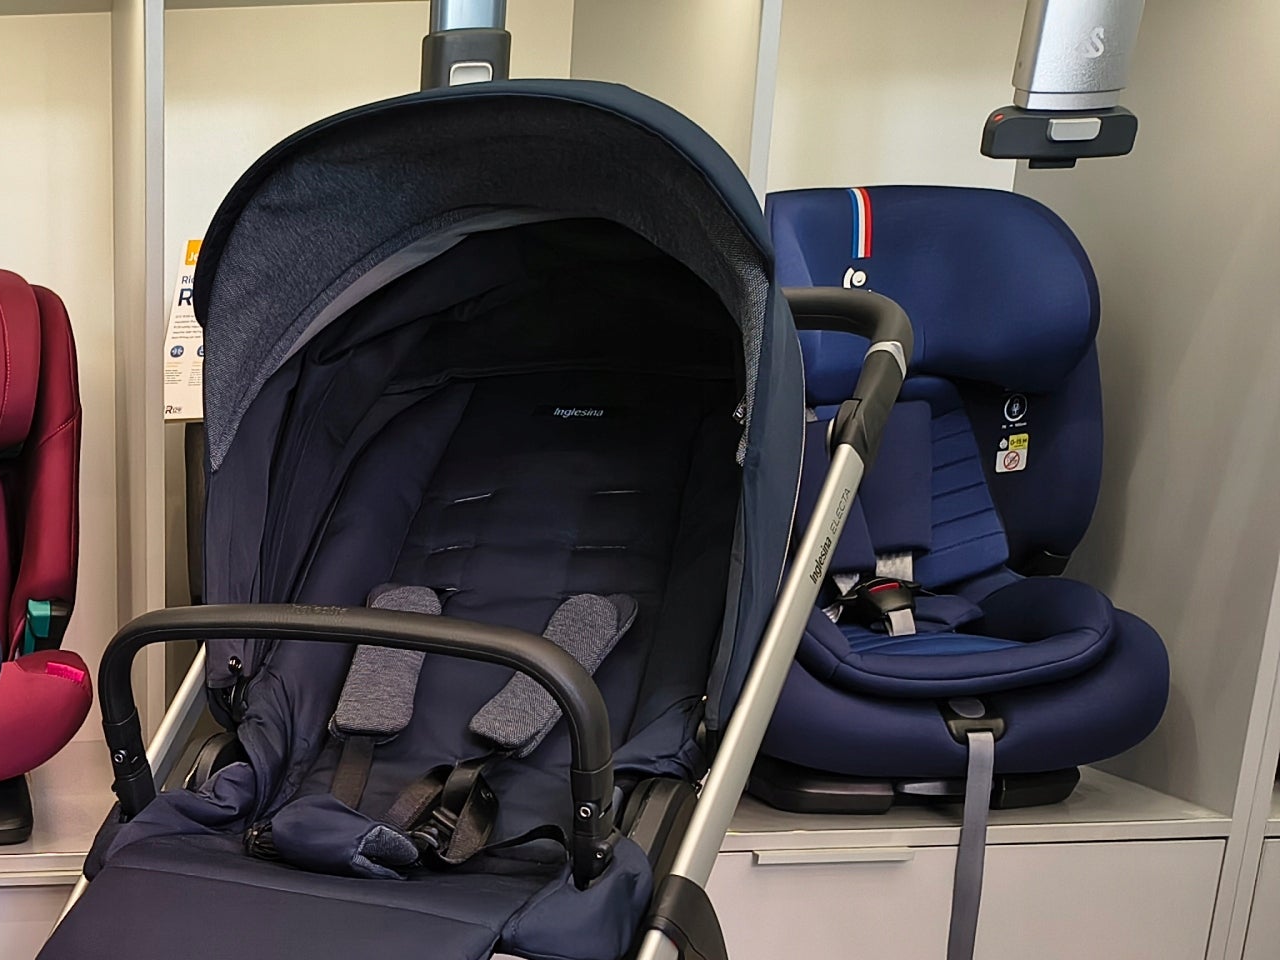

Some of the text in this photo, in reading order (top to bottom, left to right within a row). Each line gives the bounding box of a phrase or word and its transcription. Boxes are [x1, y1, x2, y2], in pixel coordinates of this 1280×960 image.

[553, 407, 604, 419] Inglesina
[809, 488, 851, 585] Inglesina ELECTA
